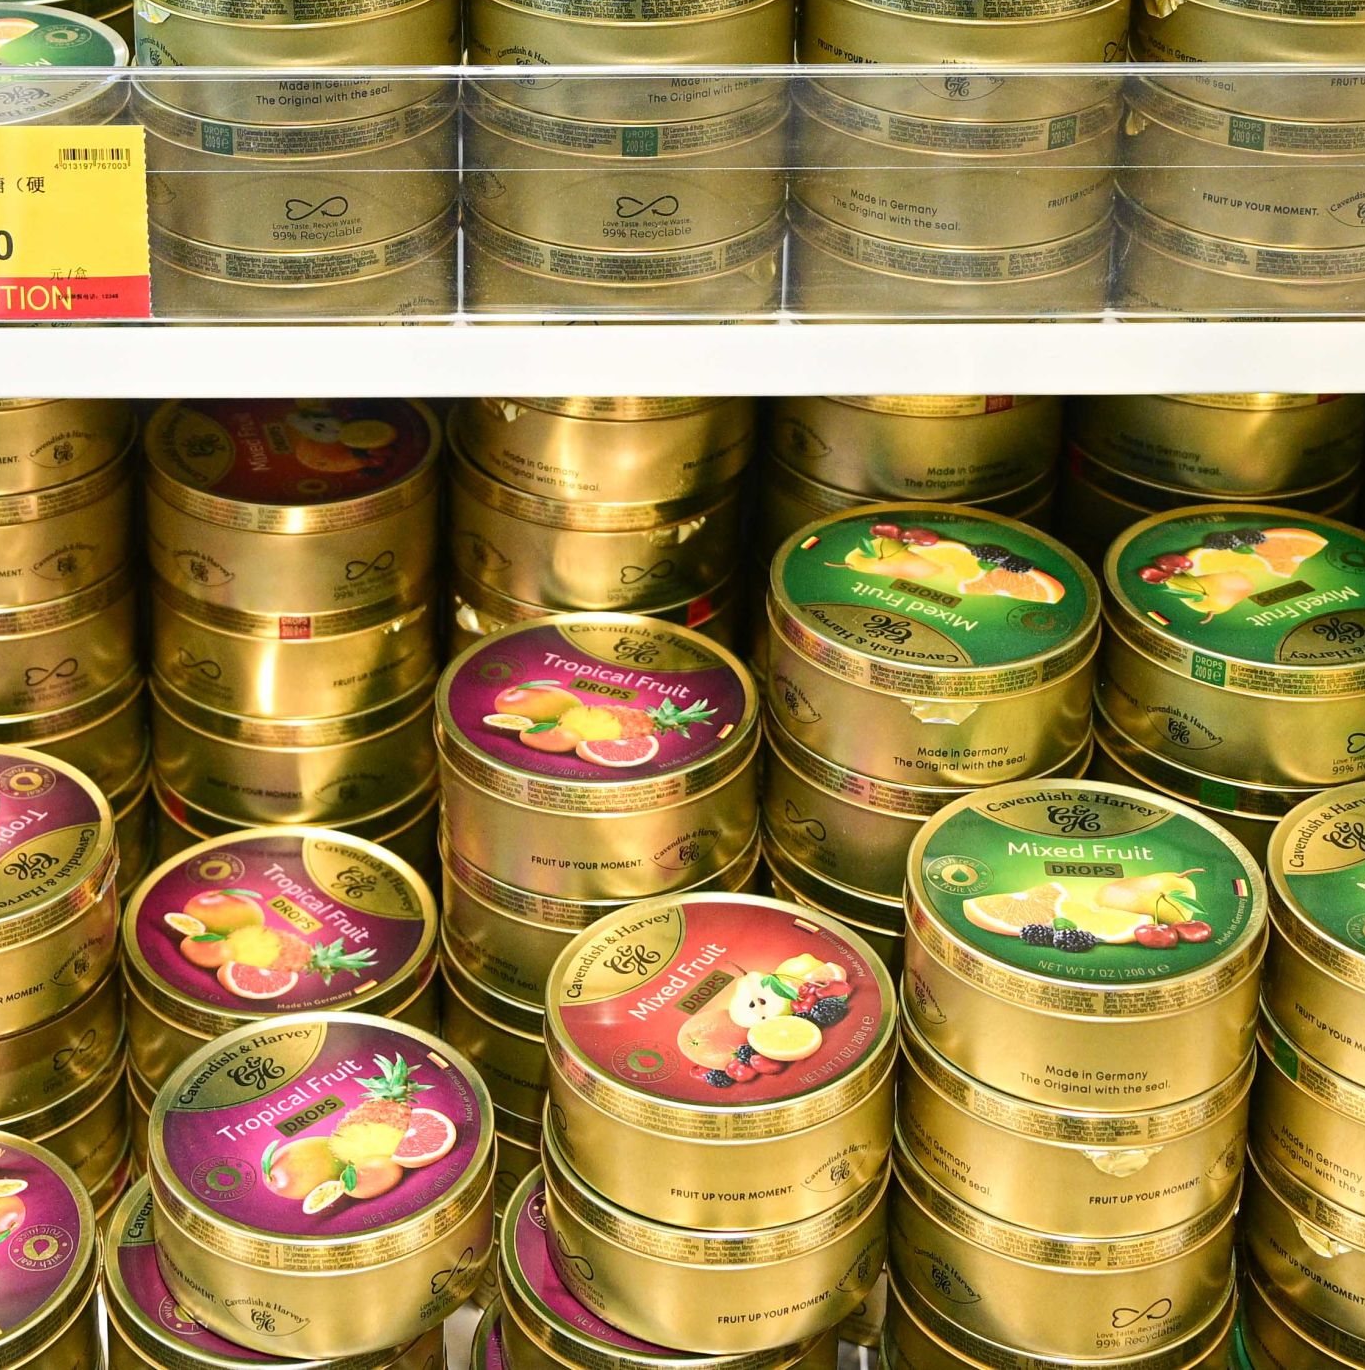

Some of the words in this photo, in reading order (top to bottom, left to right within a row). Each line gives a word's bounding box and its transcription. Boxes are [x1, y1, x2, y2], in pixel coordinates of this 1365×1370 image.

[833, 196, 847, 207] The
[849, 202, 886, 220] Original
[889, 214, 910, 226] with
[913, 218, 931, 228] the
[850, 190, 875, 202] Made
[878, 196, 887, 206] in
[890, 199, 938, 217] Germany
[1202, 193, 1228, 204] FRUIT
[1231, 199, 1242, 208] UP
[1244, 201, 1271, 213] YOUR
[603, 228, 627, 238] 99%
[630, 225, 691, 238] Recyclable
[850, 581, 908, 609] Fruit
[898, 580, 959, 606] DROPS
[1293, 586, 1359, 615] Mixed
[911, 602, 979, 632] Mixed
[1246, 600, 1298, 624] Fruit
[544, 653, 634, 687] Tropical
[635, 675, 691, 700] Fruit
[574, 682, 630, 700] DROPS
[986, 792, 1073, 813] Cavendish
[1008, 842, 1084, 858] Mixed
[1093, 844, 1153, 861] Fruit
[1052, 864, 1116, 876] DROPS
[263, 864, 326, 915] Tropical
[325, 909, 369, 943] Fruit
[273, 899, 315, 930] DROPS
[566, 945, 603, 999] Cavendish
[628, 973, 686, 1020] Mixed
[681, 943, 727, 983] Fruit
[1038, 961, 1062, 972] NET
[1067, 965, 1087, 975] WT
[1090, 966, 1095, 976] 7
[1098, 967, 1114, 977] OZ
[1148, 966, 1156, 978] g
[684, 973, 728, 1012] DROPS
[1021, 1072, 1040, 1084] The
[1043, 1077, 1090, 1095] Original
[1094, 1083, 1119, 1093] with
[1122, 1083, 1141, 1093] the
[1045, 1065, 1078, 1077] Made
[1082, 1068, 1091, 1079] in
[1095, 1068, 1148, 1083] Germany
[217, 1081, 312, 1143] Tropical
[305, 1059, 363, 1096] Fruit
[284, 1100, 338, 1134] DROPS
